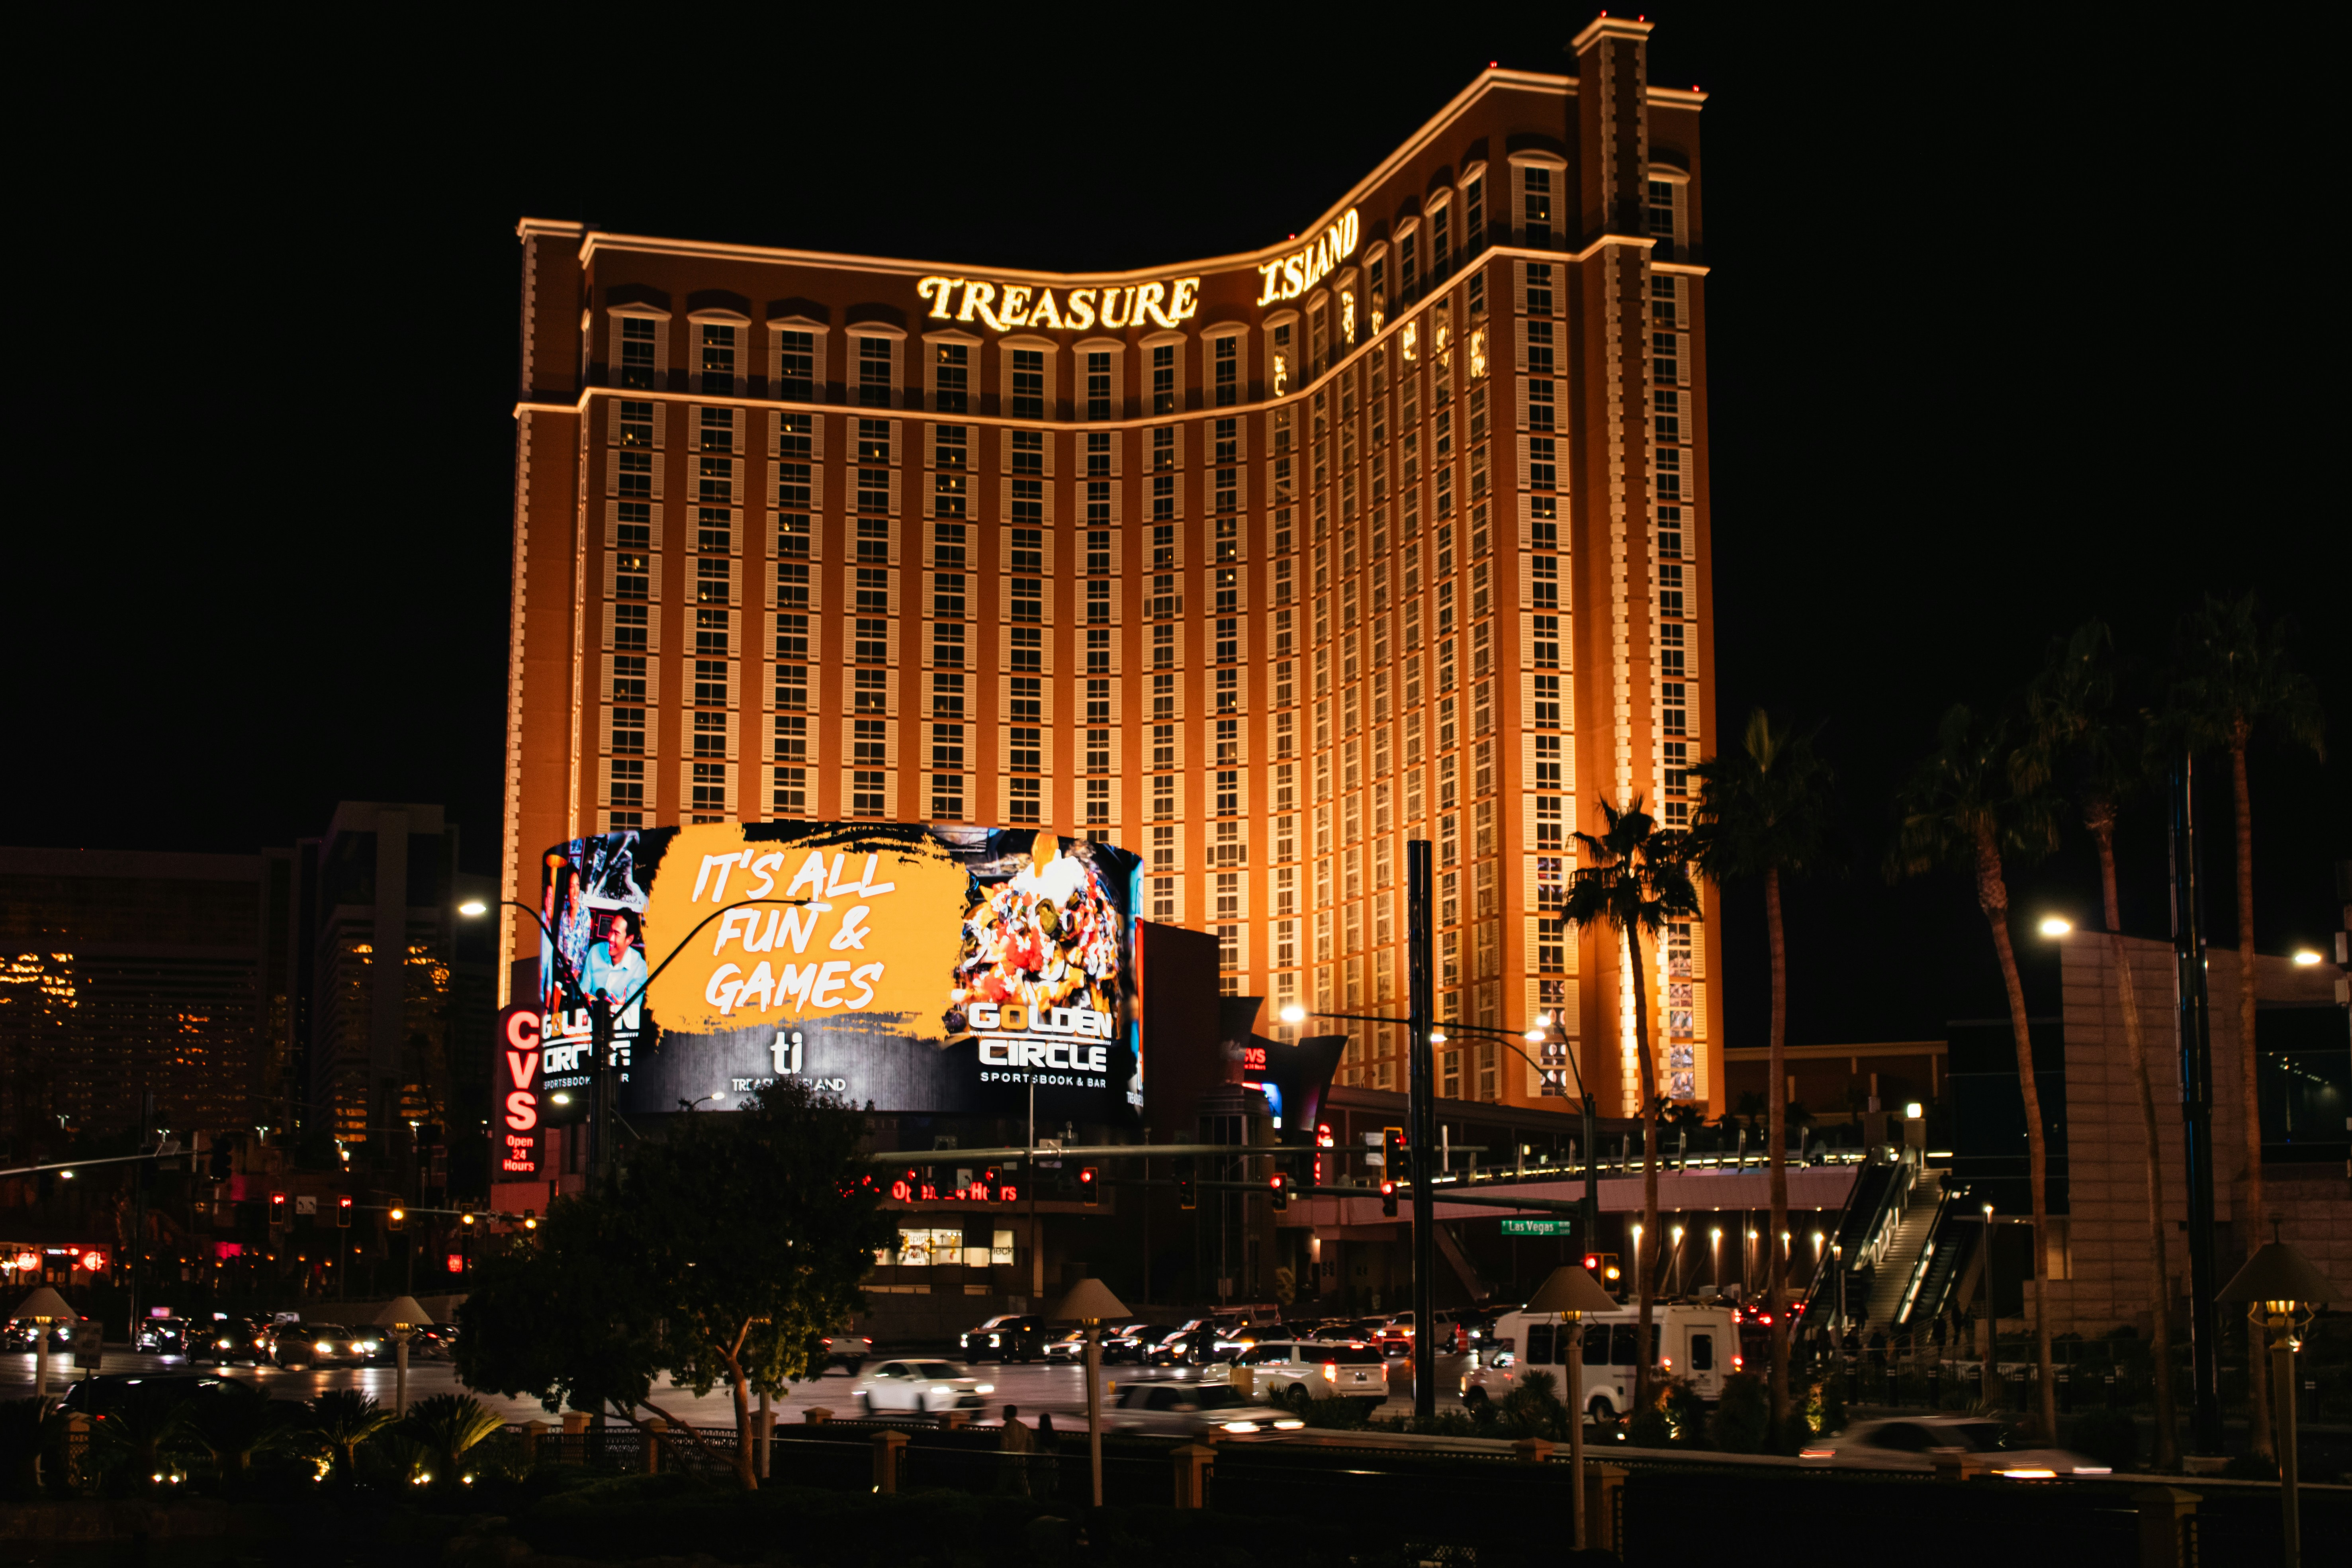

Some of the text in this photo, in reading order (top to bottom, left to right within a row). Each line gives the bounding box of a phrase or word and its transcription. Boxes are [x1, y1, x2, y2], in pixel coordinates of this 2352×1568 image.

[917, 208, 1360, 331] TREASURE ISLAND
[692, 849, 895, 902] IT'S ALL
[713, 905, 871, 956] FUN &
[705, 960, 884, 1014] GAMES
[542, 1004, 640, 1040] GOLDN
[968, 1002, 1112, 1038] GOLDEN
[505, 1010, 540, 1131] CVS
[770, 1031, 803, 1075] ti
[978, 1039, 1107, 1073] CIRCLE
[980, 1071, 1106, 1088] SPORTSBOOK & BAR
[506, 1134, 533, 1148] Open
[512, 1149, 526, 1160] 24
[503, 1159, 534, 1171] Hours
[1509, 1220, 1524, 1231] Las
[1526, 1220, 1554, 1235] Vegas
